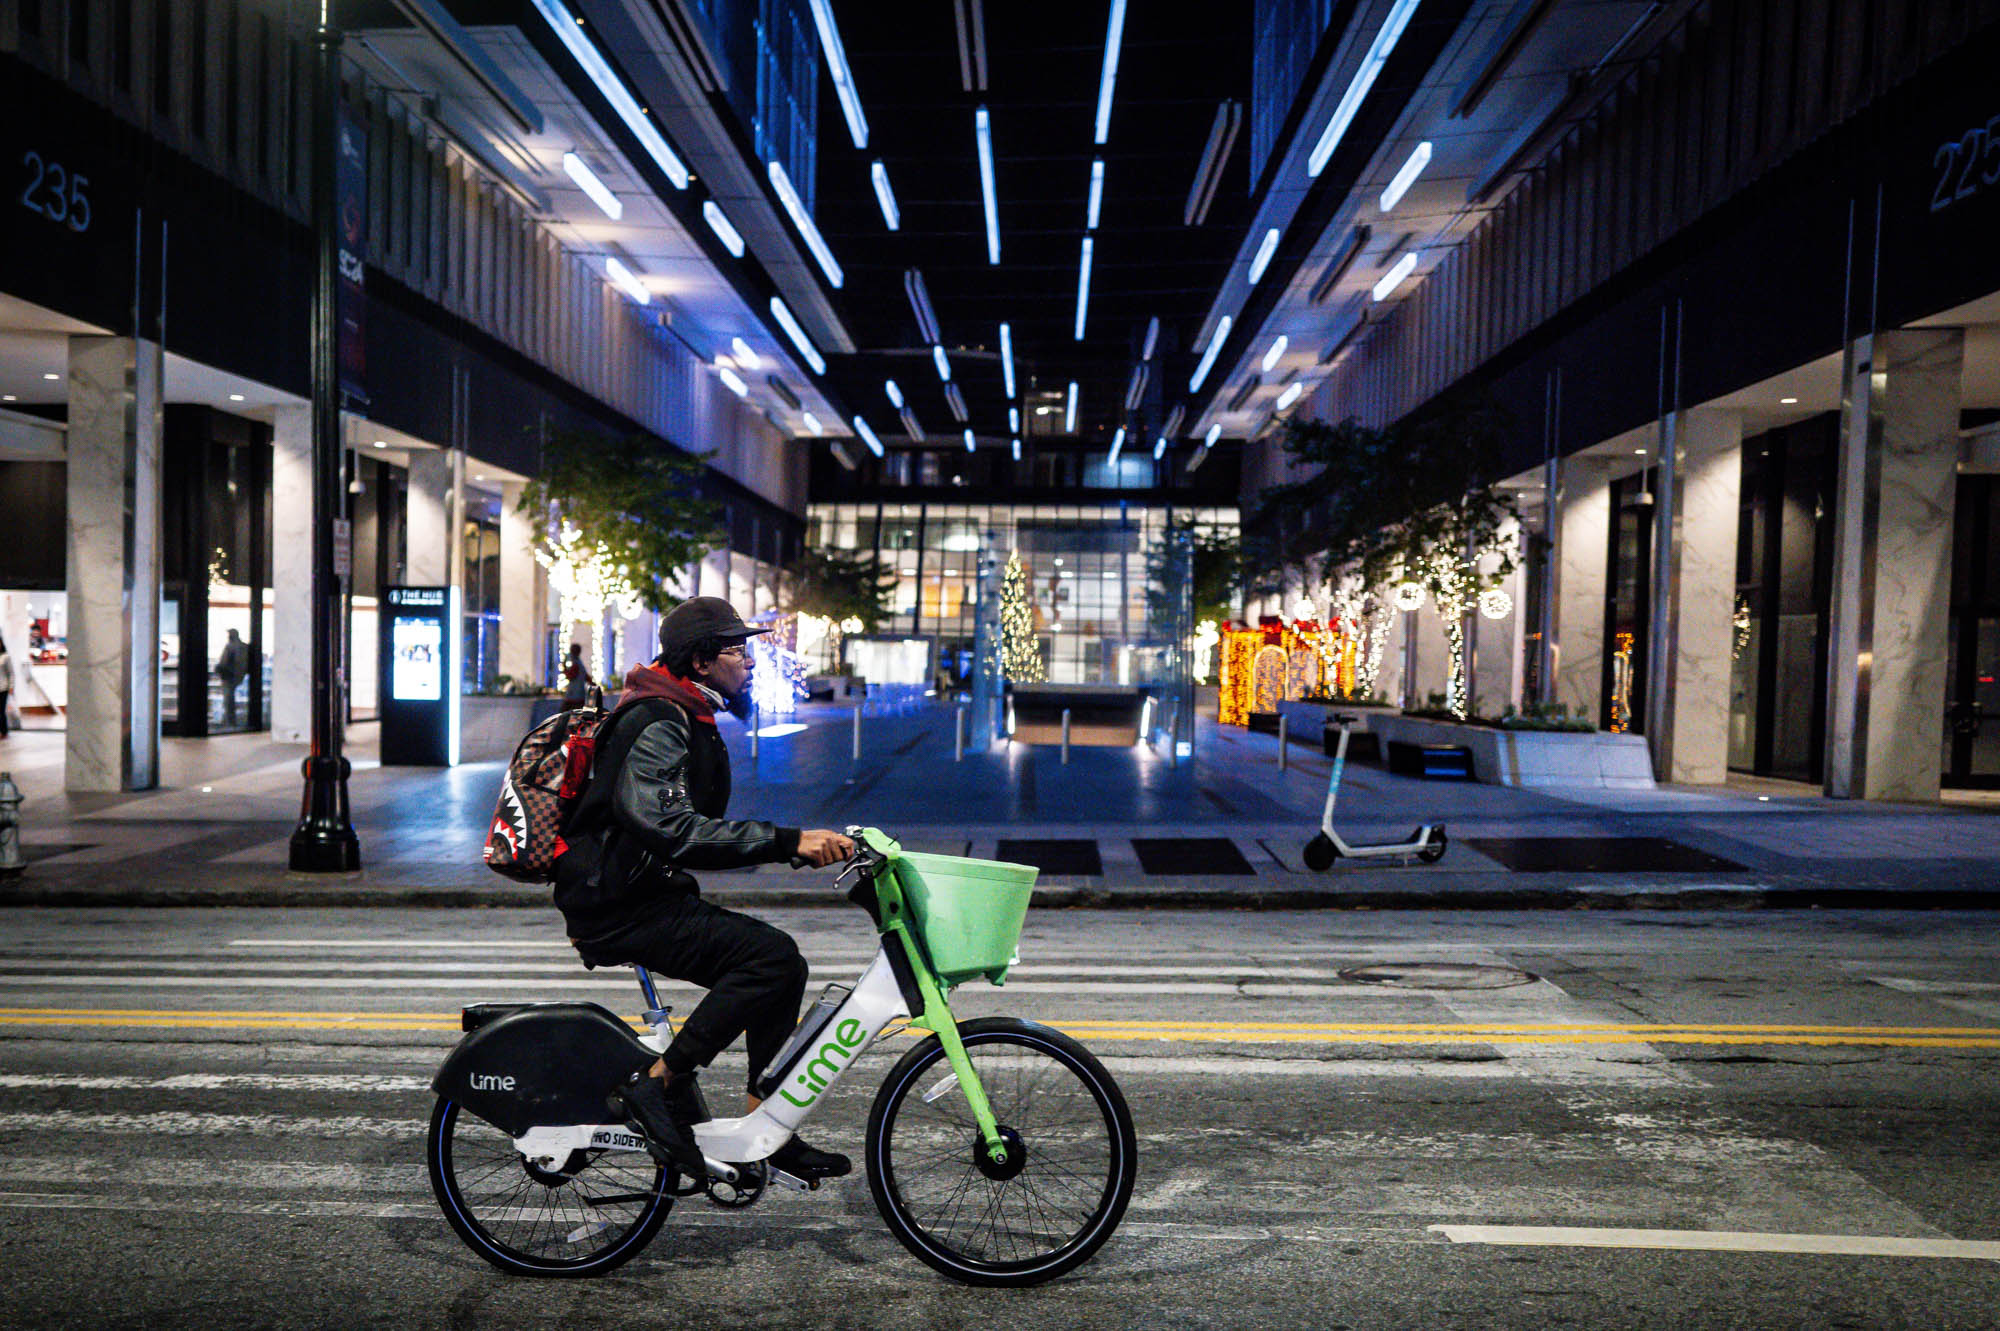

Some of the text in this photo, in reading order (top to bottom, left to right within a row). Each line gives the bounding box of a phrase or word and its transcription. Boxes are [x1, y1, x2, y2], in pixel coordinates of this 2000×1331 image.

[23, 151, 91, 232] 235
[470, 1072, 516, 1091] Lime
[779, 1018, 867, 1108] Lime
[613, 1133, 648, 1149] SIDEW
